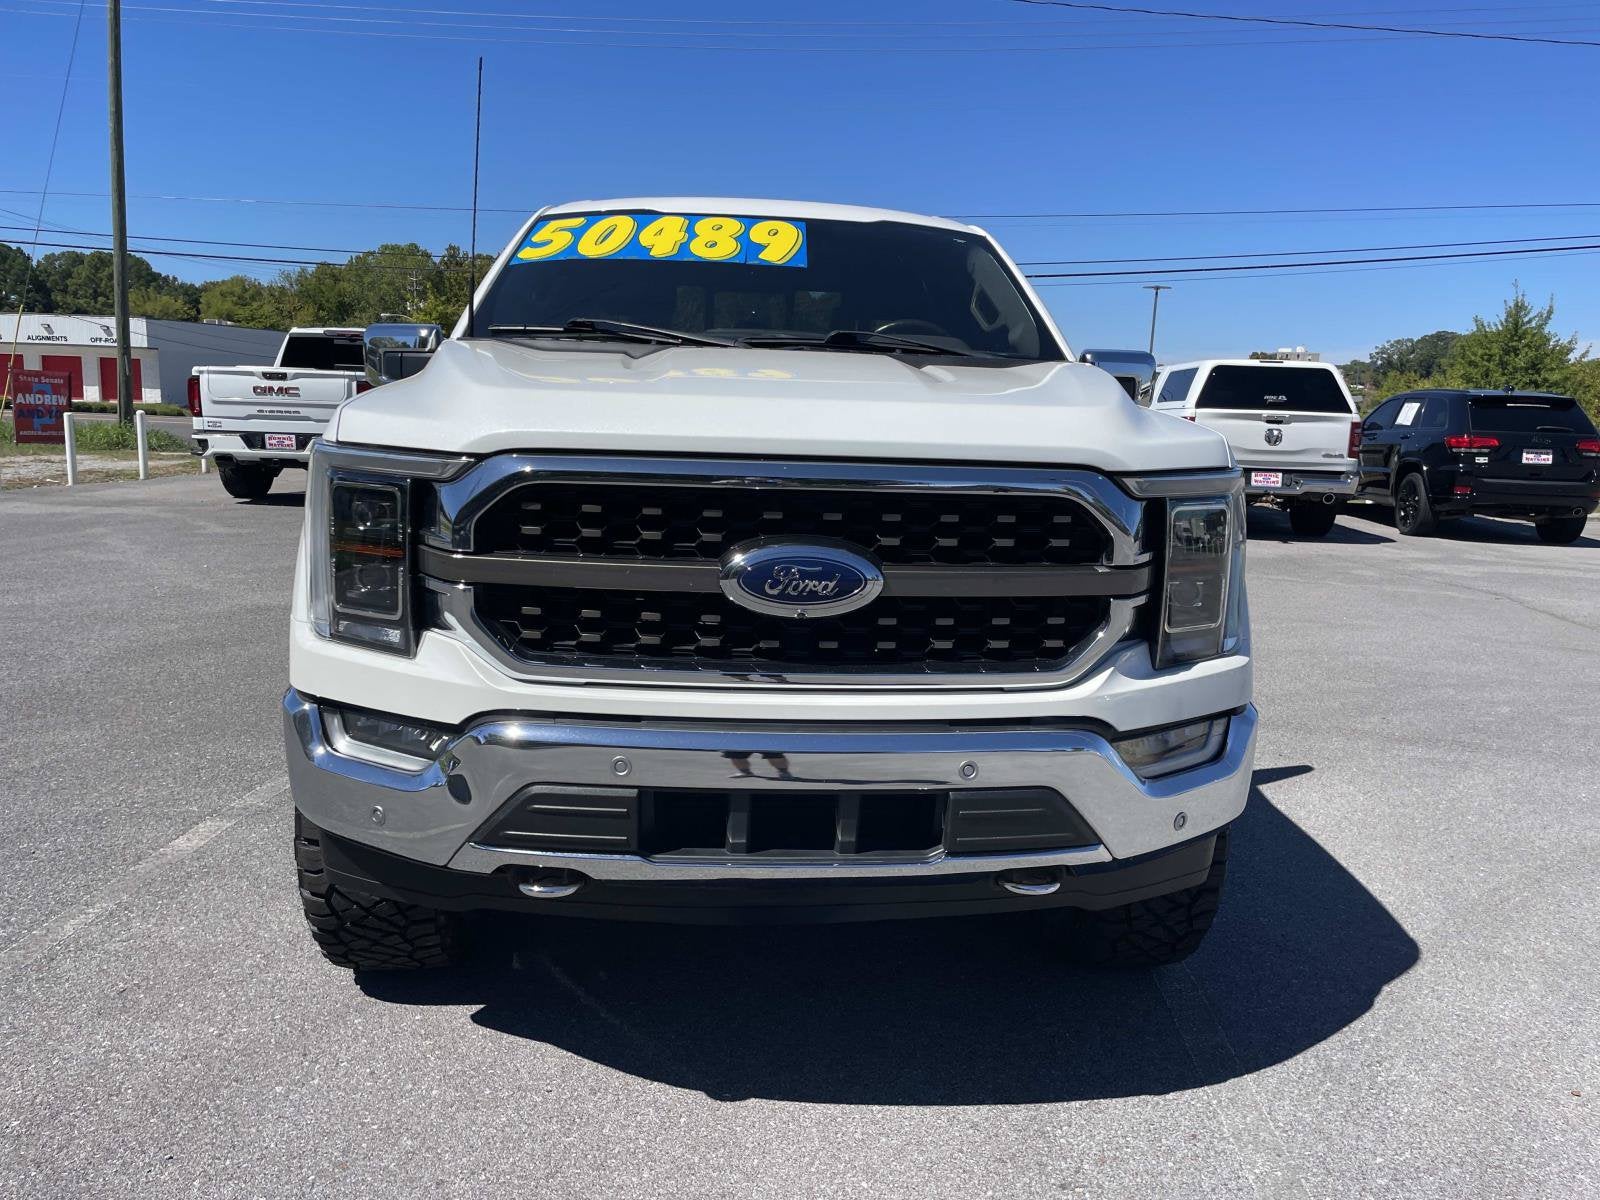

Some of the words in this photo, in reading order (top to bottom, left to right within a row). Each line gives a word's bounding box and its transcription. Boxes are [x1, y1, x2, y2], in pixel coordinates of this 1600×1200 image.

[516, 215, 803, 265] 50489
[90, 336, 118, 344] OFF-ROA
[252, 385, 301, 398] GMC
[16, 393, 68, 405] ANDREW
[764, 564, 842, 596] Ford
